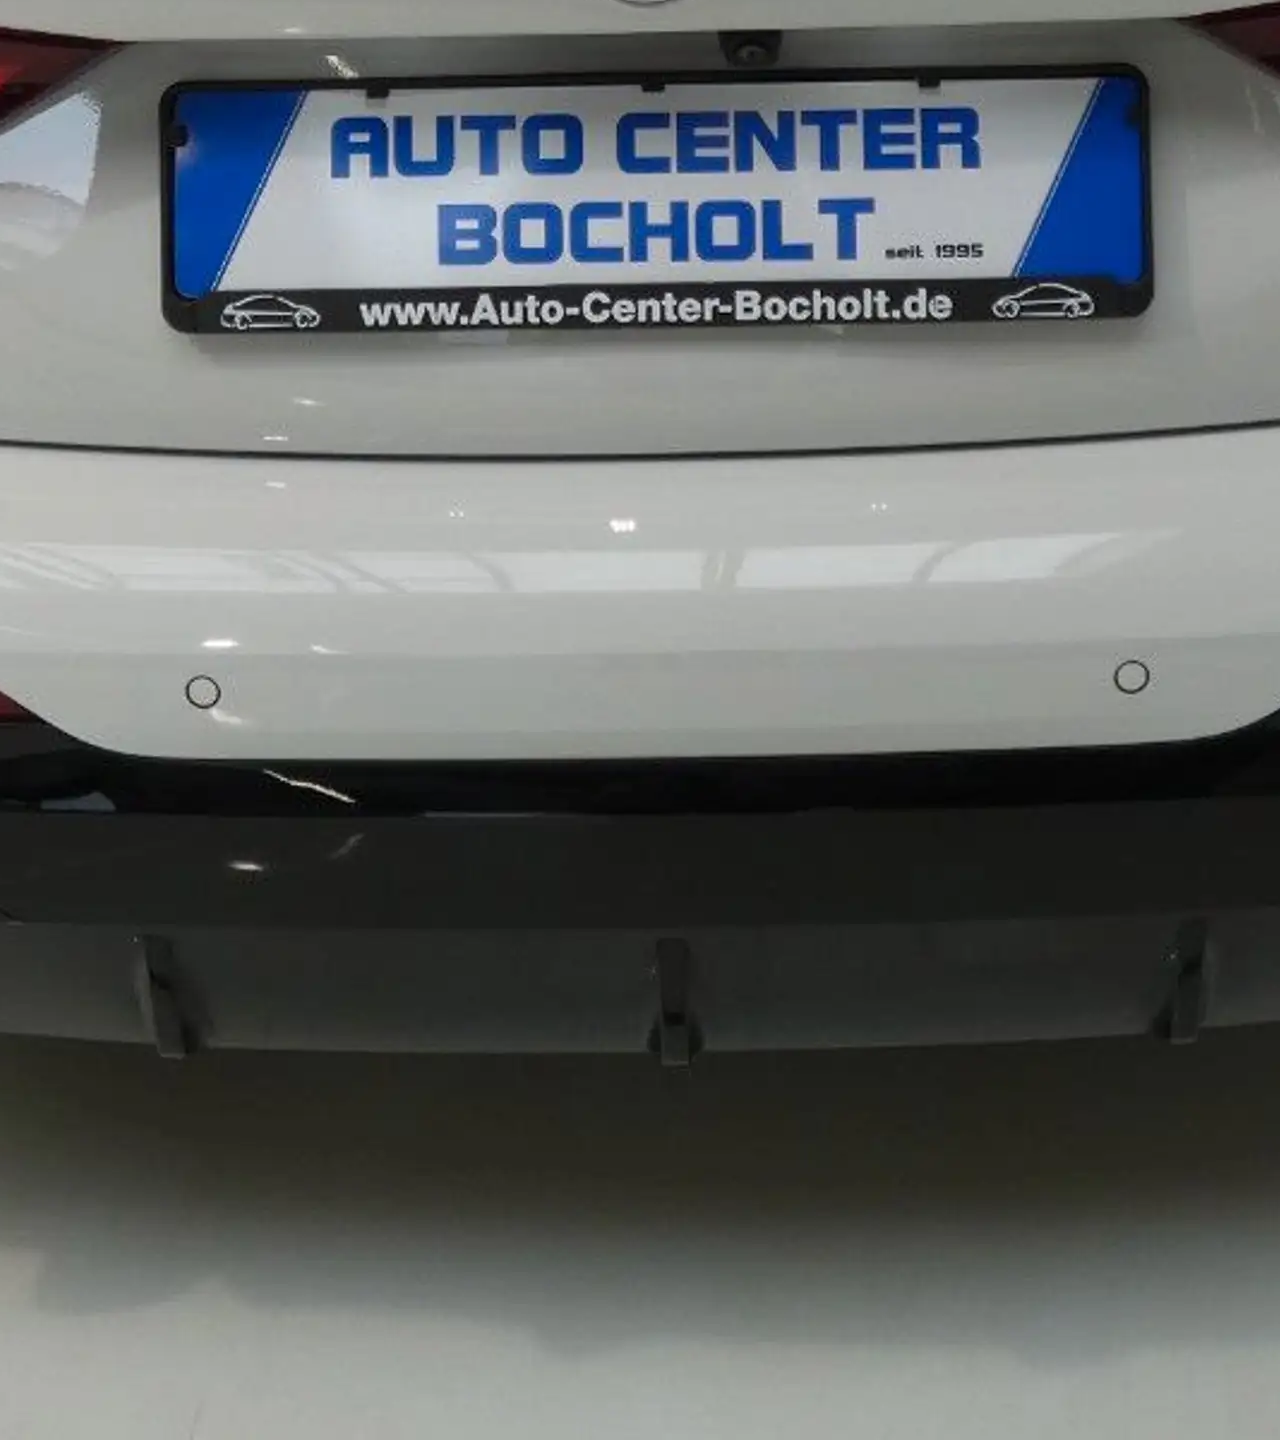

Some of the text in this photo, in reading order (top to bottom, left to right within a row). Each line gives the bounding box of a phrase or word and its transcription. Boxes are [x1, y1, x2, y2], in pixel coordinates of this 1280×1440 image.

[330, 106, 982, 178] AUTO CENTER
[436, 197, 876, 266] BOCHOLT
[885, 243, 984, 259] seit 1995
[359, 287, 954, 327] www.Auto-Center-Bocholt.de
